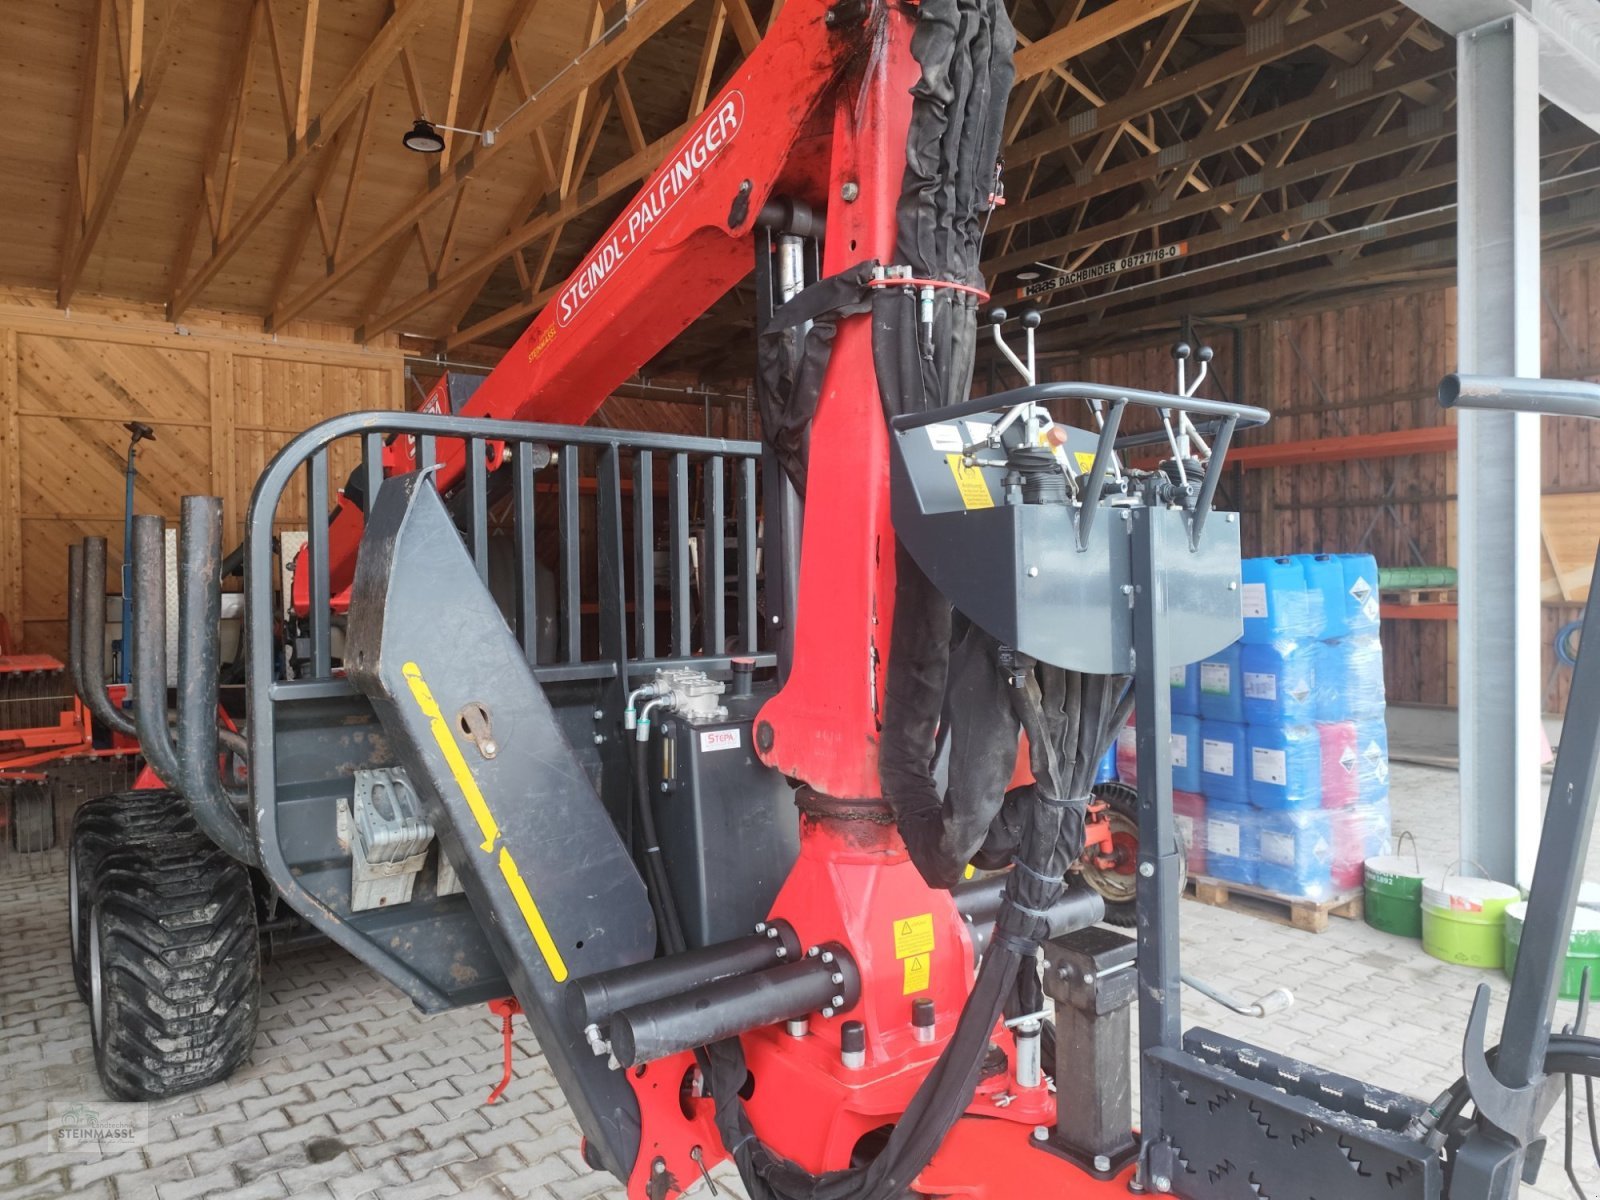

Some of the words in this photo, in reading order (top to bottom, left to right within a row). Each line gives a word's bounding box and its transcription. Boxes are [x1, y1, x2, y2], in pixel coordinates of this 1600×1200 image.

[560, 101, 738, 321] STEINDL-PALFINGER
[1026, 279, 1056, 297] Haas
[1059, 263, 1116, 287] DACHBINDER
